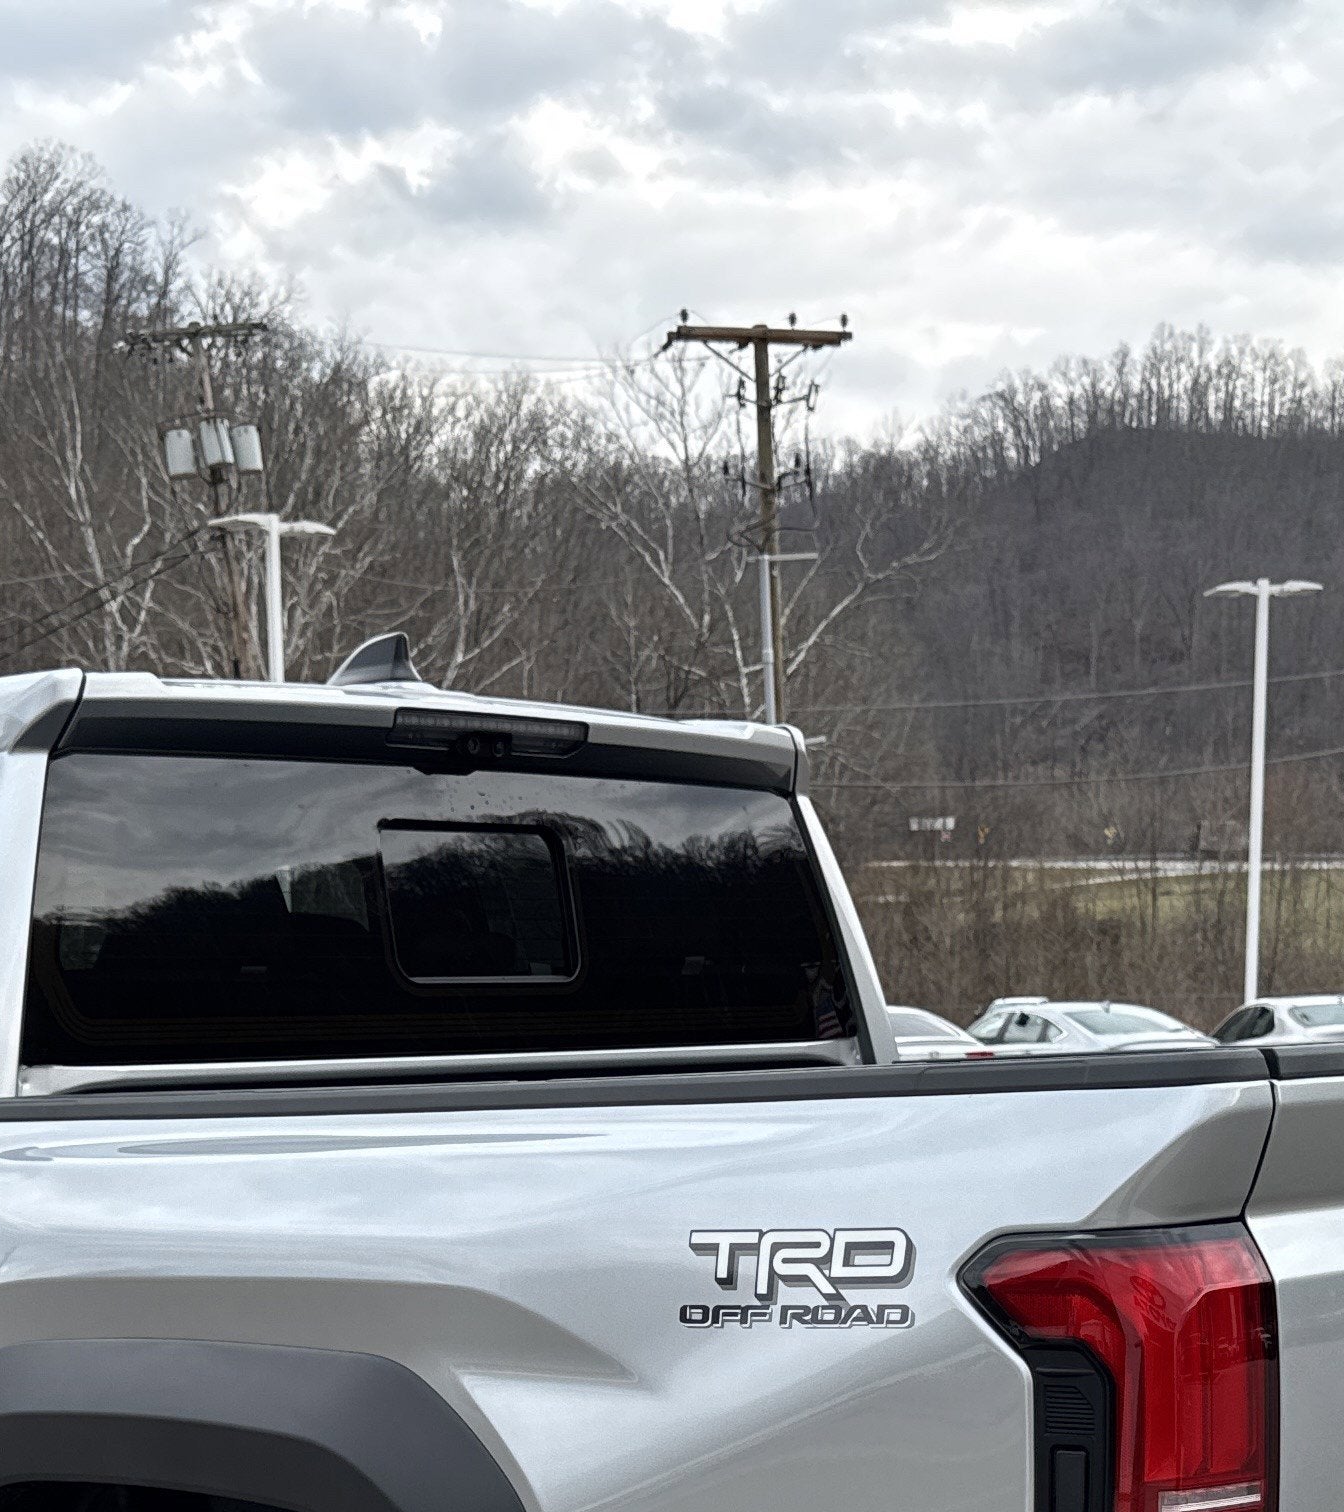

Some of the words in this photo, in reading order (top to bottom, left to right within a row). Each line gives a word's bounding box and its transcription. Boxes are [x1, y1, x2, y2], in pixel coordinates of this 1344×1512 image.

[688, 1227, 917, 1305] TRD
[679, 1304, 773, 1328] OFF
[779, 1304, 916, 1329] ROAD
